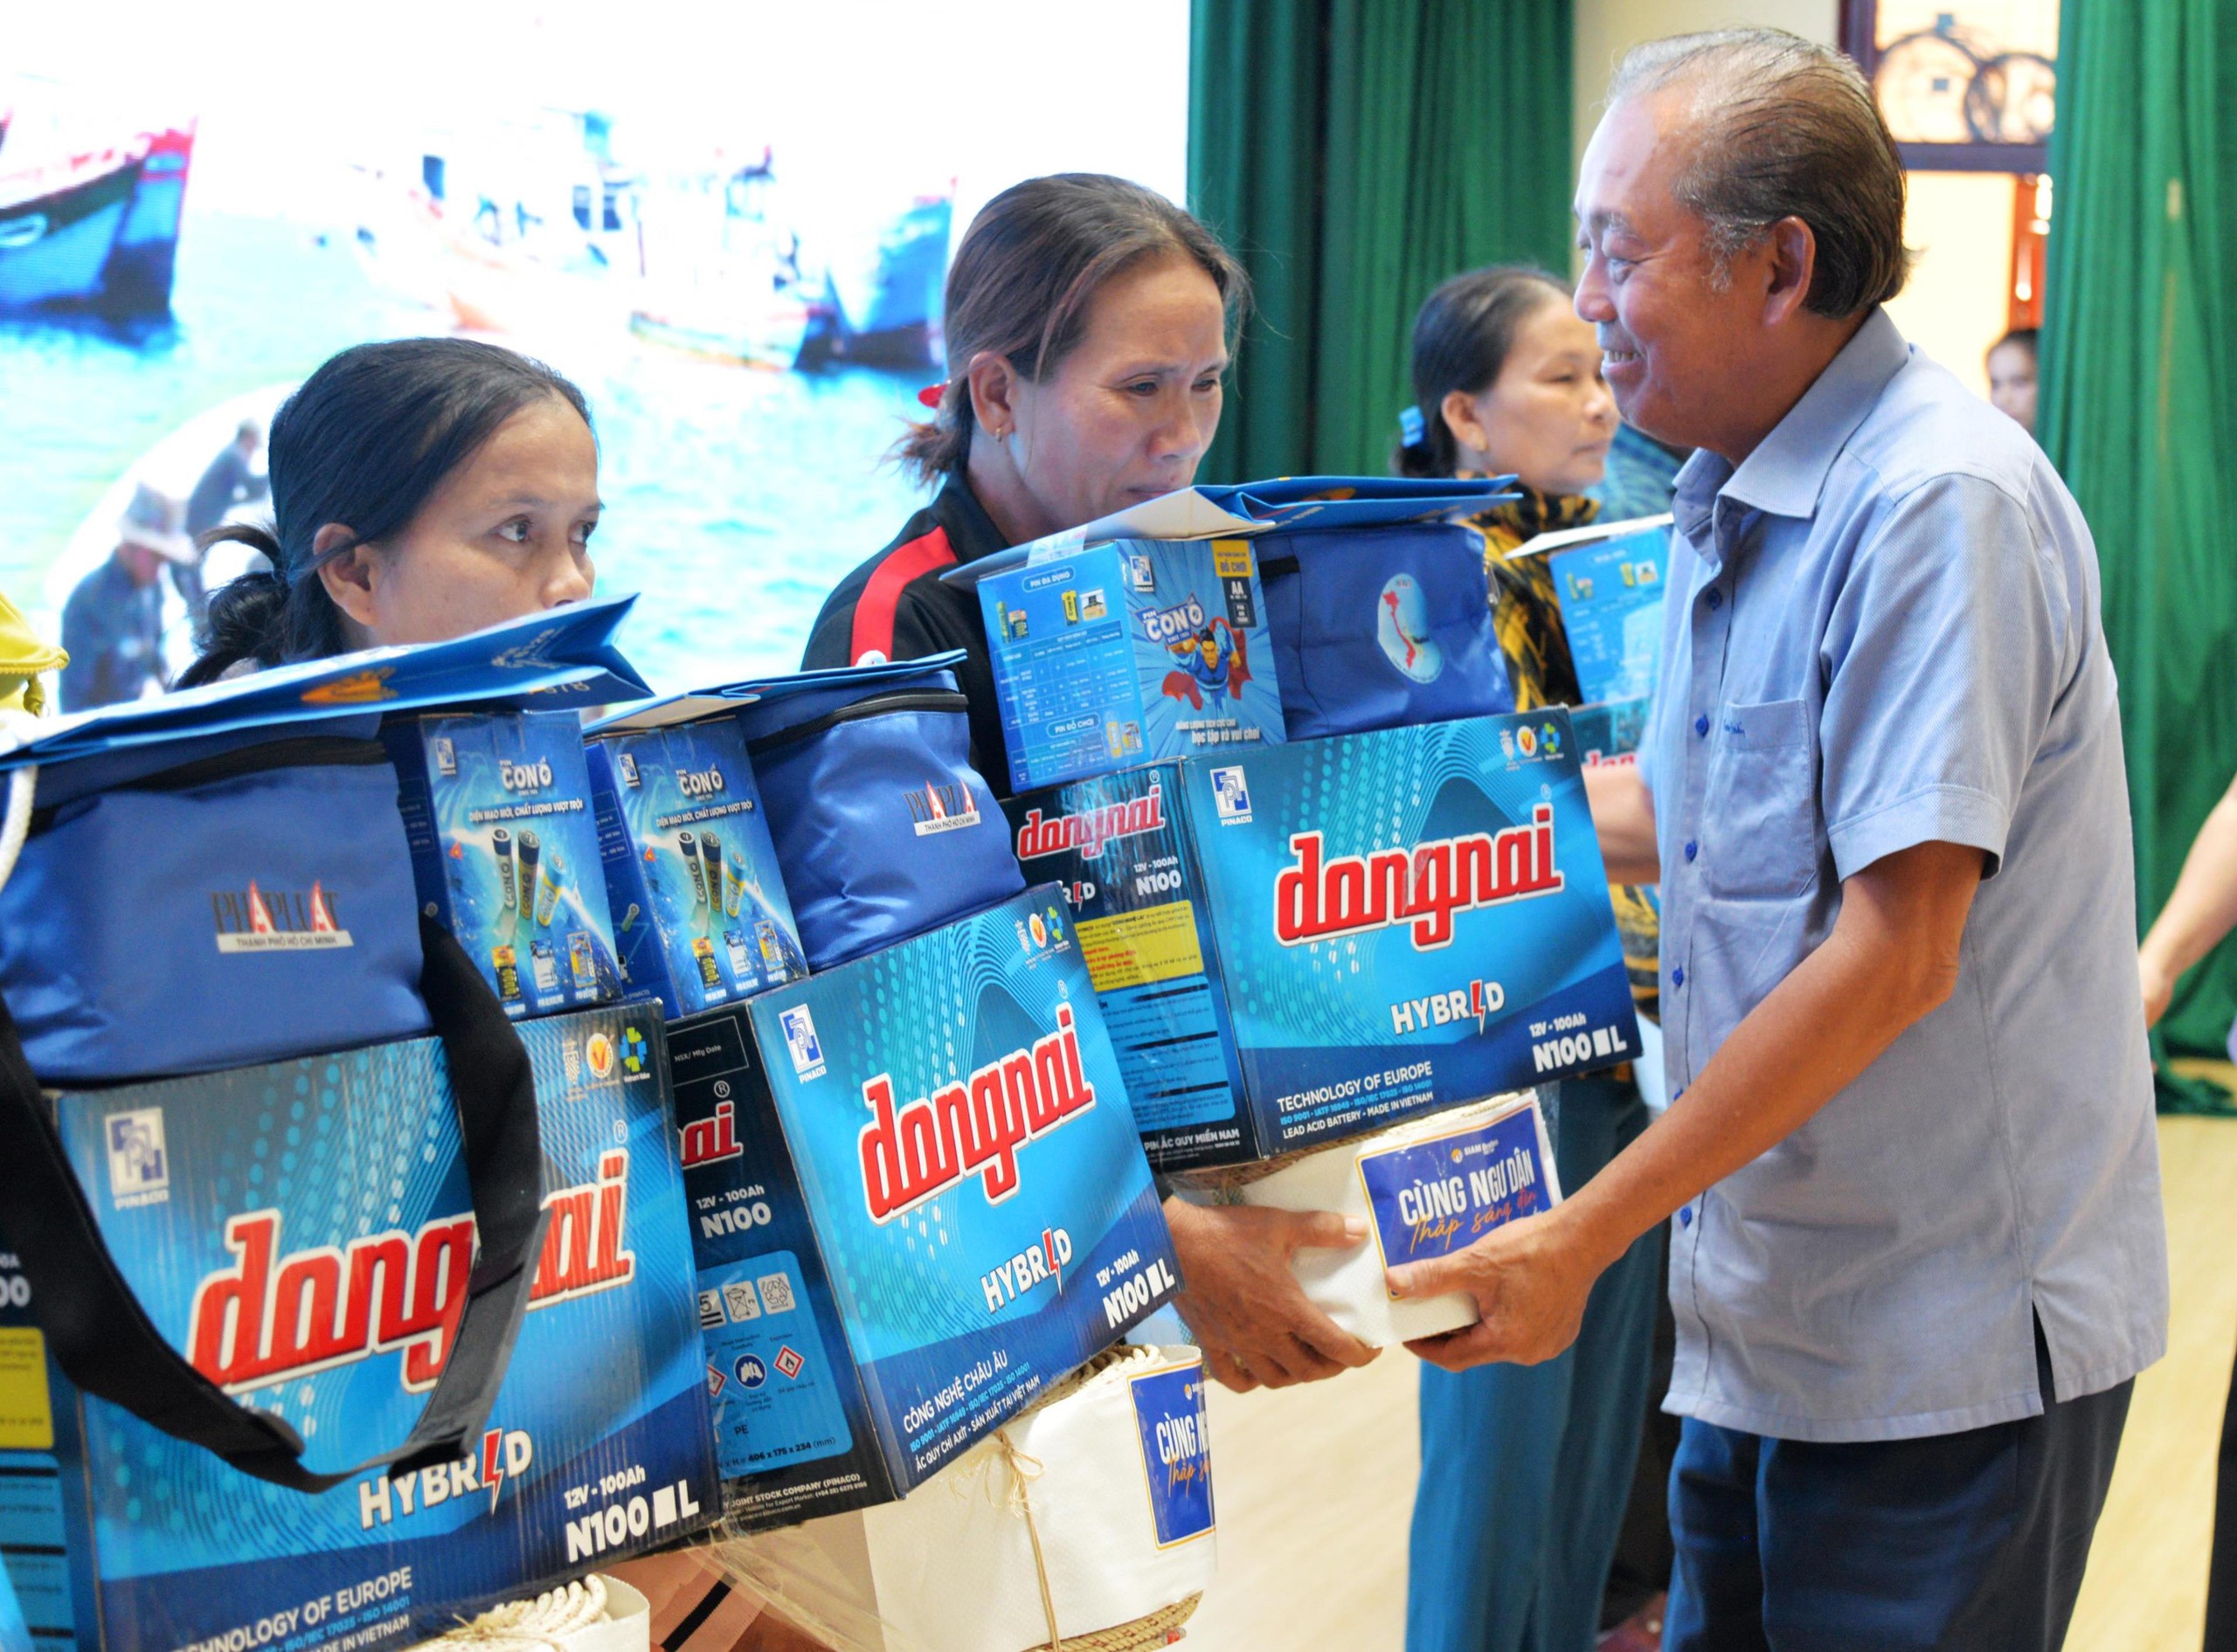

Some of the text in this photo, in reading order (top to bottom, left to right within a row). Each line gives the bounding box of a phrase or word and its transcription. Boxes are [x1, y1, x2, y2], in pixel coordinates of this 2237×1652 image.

[1221, 814, 1253, 826] PINACO
[1134, 855, 1179, 873] 12V 100Ah
[1136, 869, 1182, 896] N100
[1274, 802, 1564, 951] dongnai
[1390, 978, 1505, 1035] HYBRID
[1529, 1011, 1587, 1038] 12V 100Ah
[706, 1044, 722, 1054] Date
[1532, 1033, 1592, 1073] N100
[798, 1064, 828, 1085] PINACO
[1278, 1061, 1433, 1113] TECHNOLOGY OF EUROPE
[857, 1001, 1097, 1227] dongnai
[1283, 1091, 1434, 1139] LEAD ACID BATTERY MADE IN VIETNAM
[1175, 1136, 1194, 1147] QUY
[1218, 1128, 1240, 1139] NAM
[1464, 1144, 1482, 1156] SIAM
[114, 1188, 170, 1212] PINACO
[696, 1184, 765, 1210] 12V 100Ah
[1398, 1176, 1468, 1227] CÙNG
[1506, 1146, 1535, 1194] DÂN
[700, 1201, 772, 1239] N100
[980, 1227, 1073, 1314] HYBRID
[1096, 1248, 1139, 1288] 12V 100Ah
[1103, 1273, 1150, 1330] N100
[904, 1349, 1008, 1434] CÔNG NGHỆ CHÂU ÂU
[910, 1440, 921, 1453] ISO
[920, 1431, 935, 1446] 9001
[968, 1390, 989, 1412] ISO/IEC
[988, 1380, 1004, 1397] 17025
[1006, 1372, 1016, 1385] ISO
[1015, 1361, 1030, 1378] 14001
[734, 1424, 749, 1435] PE
[926, 1447, 942, 1465] QUY
[970, 1412, 986, 1433] SẢN
[986, 1399, 1003, 1423] XUẤT
[1001, 1393, 1014, 1410] TẠI
[1013, 1384, 1027, 1402] VIỆT
[1025, 1373, 1041, 1394] NAM
[1156, 1412, 1197, 1465] CÙNG
[748, 1451, 765, 1462] 406
[773, 1447, 787, 1457] 175
[795, 1441, 812, 1452] 234
[813, 1436, 836, 1449] (mm)
[358, 1427, 533, 1530] HYBRID
[564, 1464, 646, 1510] 12V 100Ah
[731, 1473, 861, 1509] JOINT STOCK COMPANY (PINACO)
[565, 1496, 650, 1564] N100
[303, 1566, 413, 1626] OF EUROPE
[343, 1614, 410, 1651] IN VIETNAM
